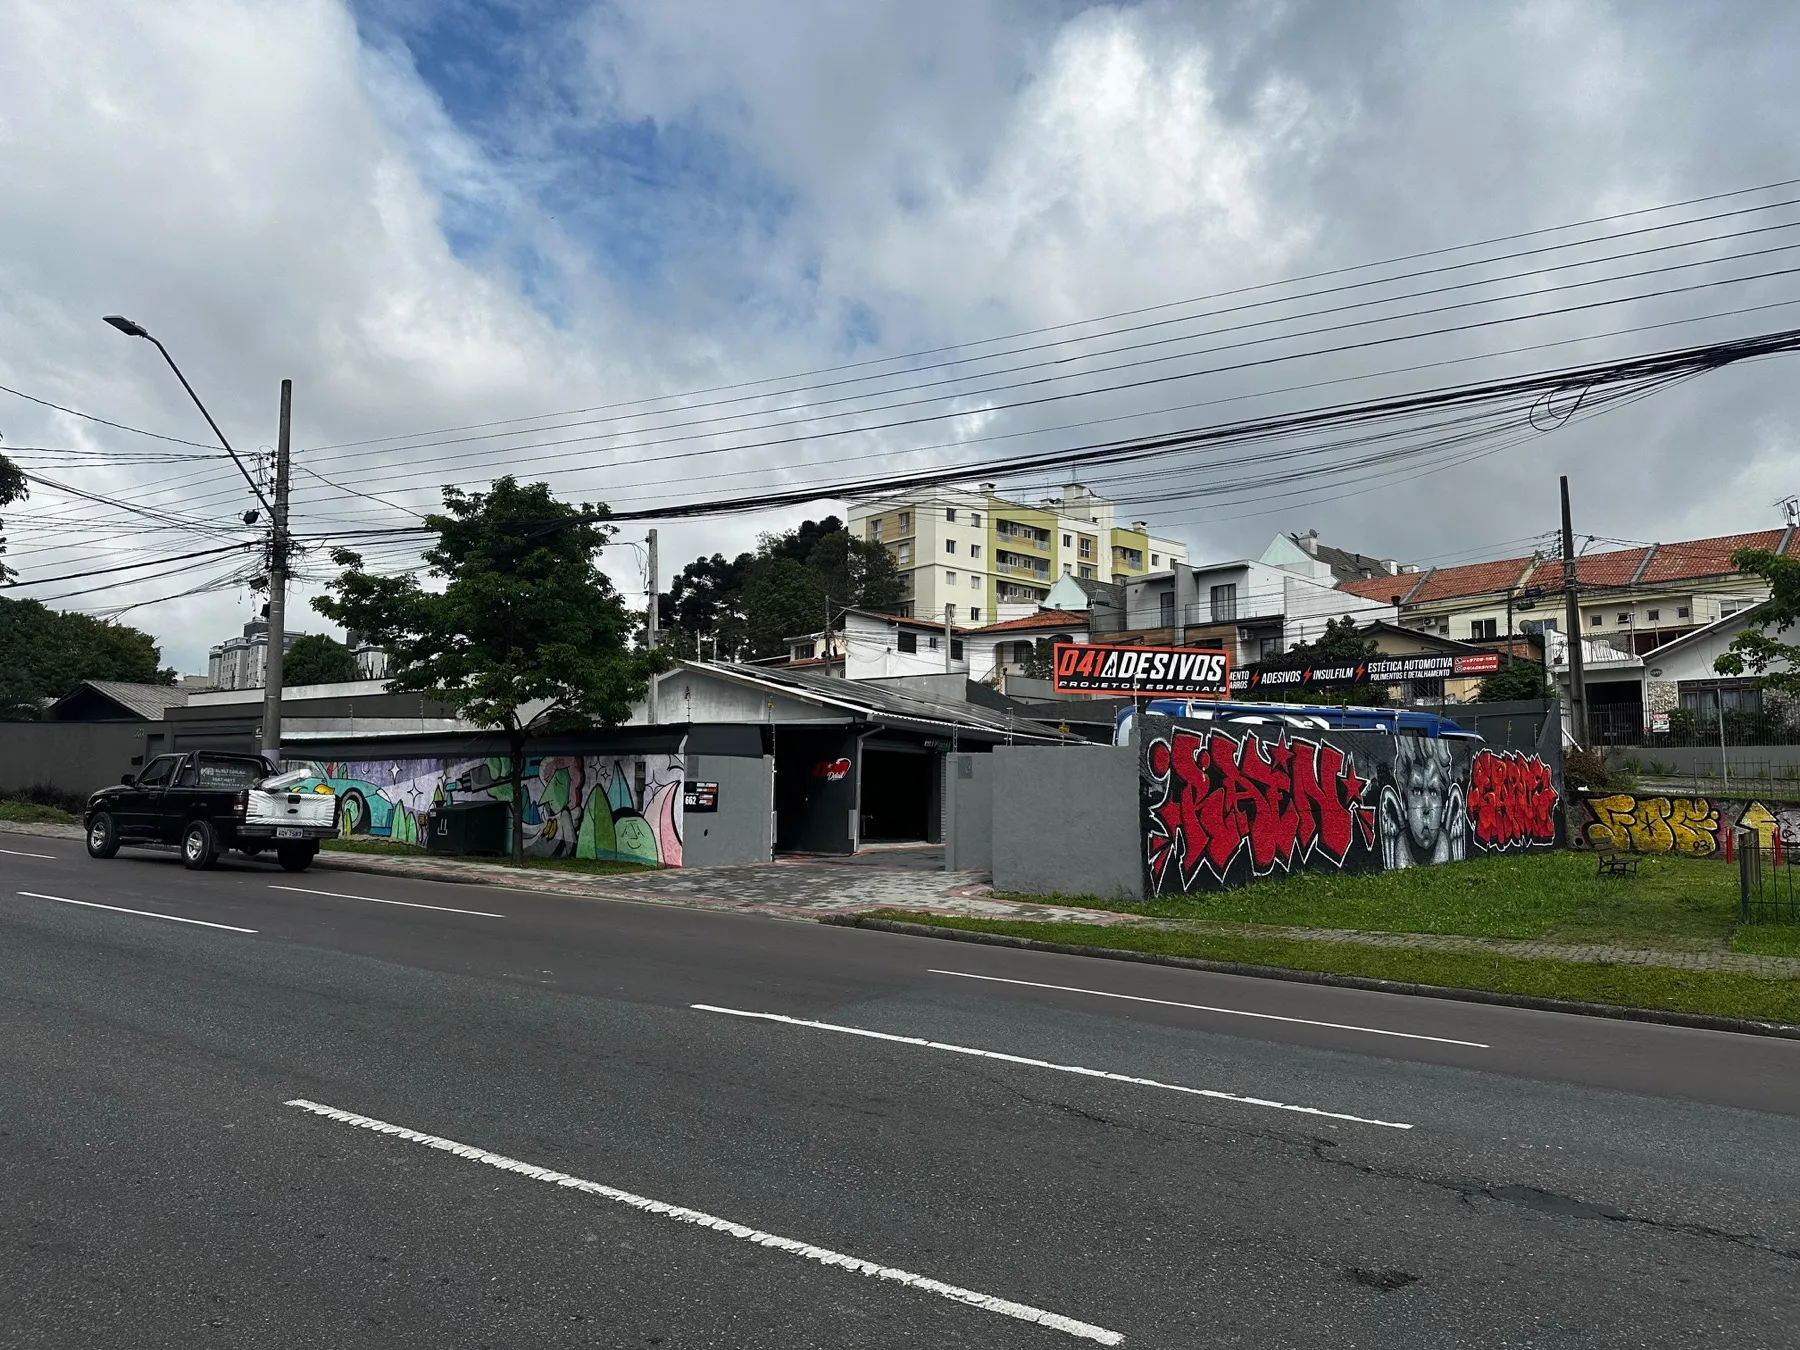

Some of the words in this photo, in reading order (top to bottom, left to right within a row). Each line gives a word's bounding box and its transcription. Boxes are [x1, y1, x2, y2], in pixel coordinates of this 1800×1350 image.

[1058, 649, 1227, 682] 041ADESIVOS
[1367, 659, 1403, 673] ESTÉTICA
[1403, 657, 1454, 671] AUTOMOTIVA
[1260, 670, 1302, 685] ADESIVOS
[1312, 667, 1355, 681] INSULFILM
[1370, 672, 1403, 682] POLIMENTOS
[1403, 671, 1408, 679] E
[1407, 669, 1451, 679] DETALHAMENTO
[1058, 680, 1141, 690] PROJETOS
[1145, 682, 1227, 693] ESPECIAIS
